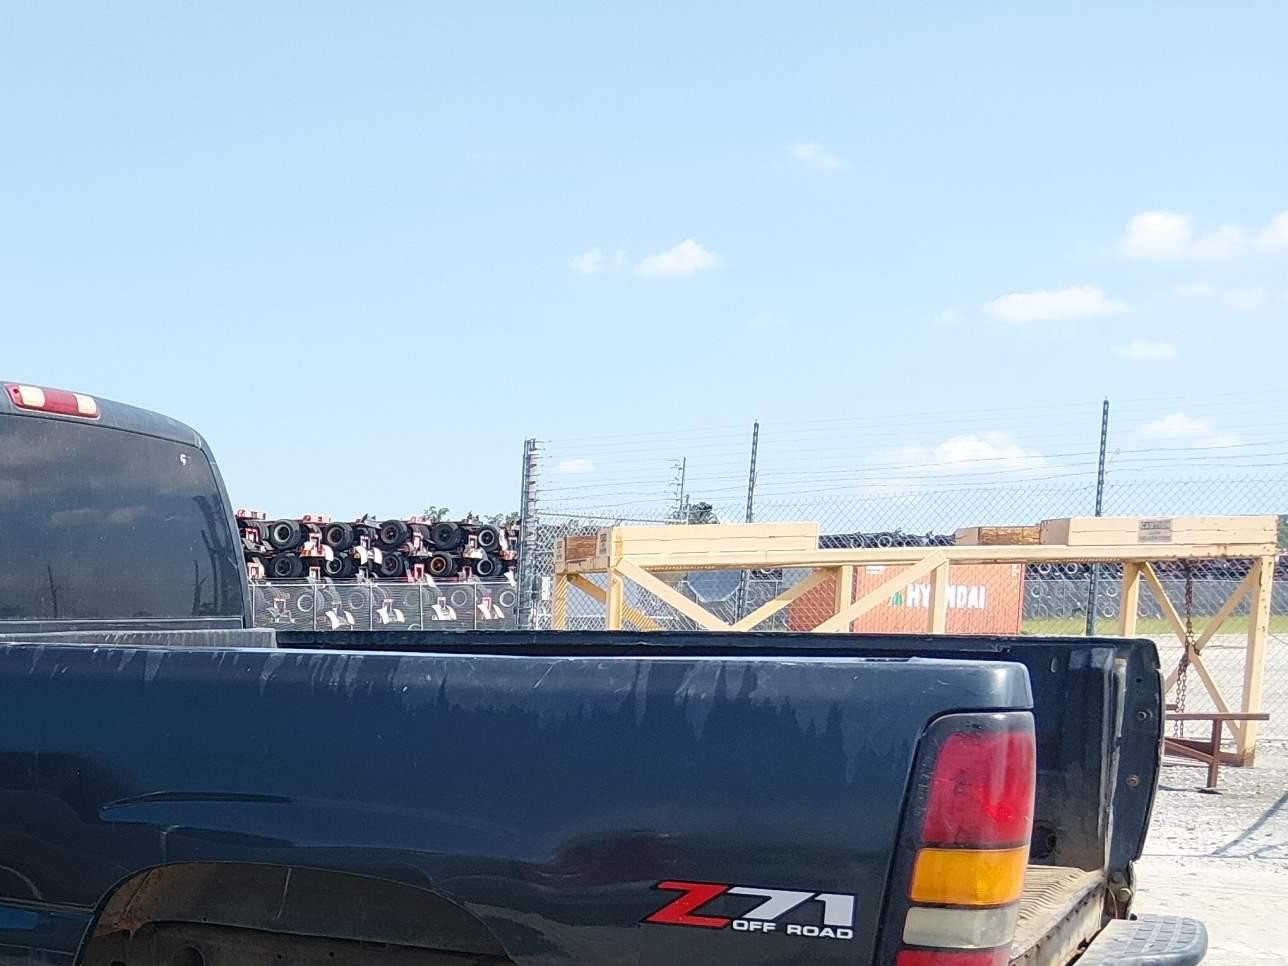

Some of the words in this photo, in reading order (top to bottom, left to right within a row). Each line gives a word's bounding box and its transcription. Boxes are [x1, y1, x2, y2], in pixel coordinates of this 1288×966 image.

[906, 584, 986, 609] HYNDAI
[645, 880, 855, 929] Z71
[732, 919, 777, 933] OFF
[786, 925, 854, 940] ROAD
